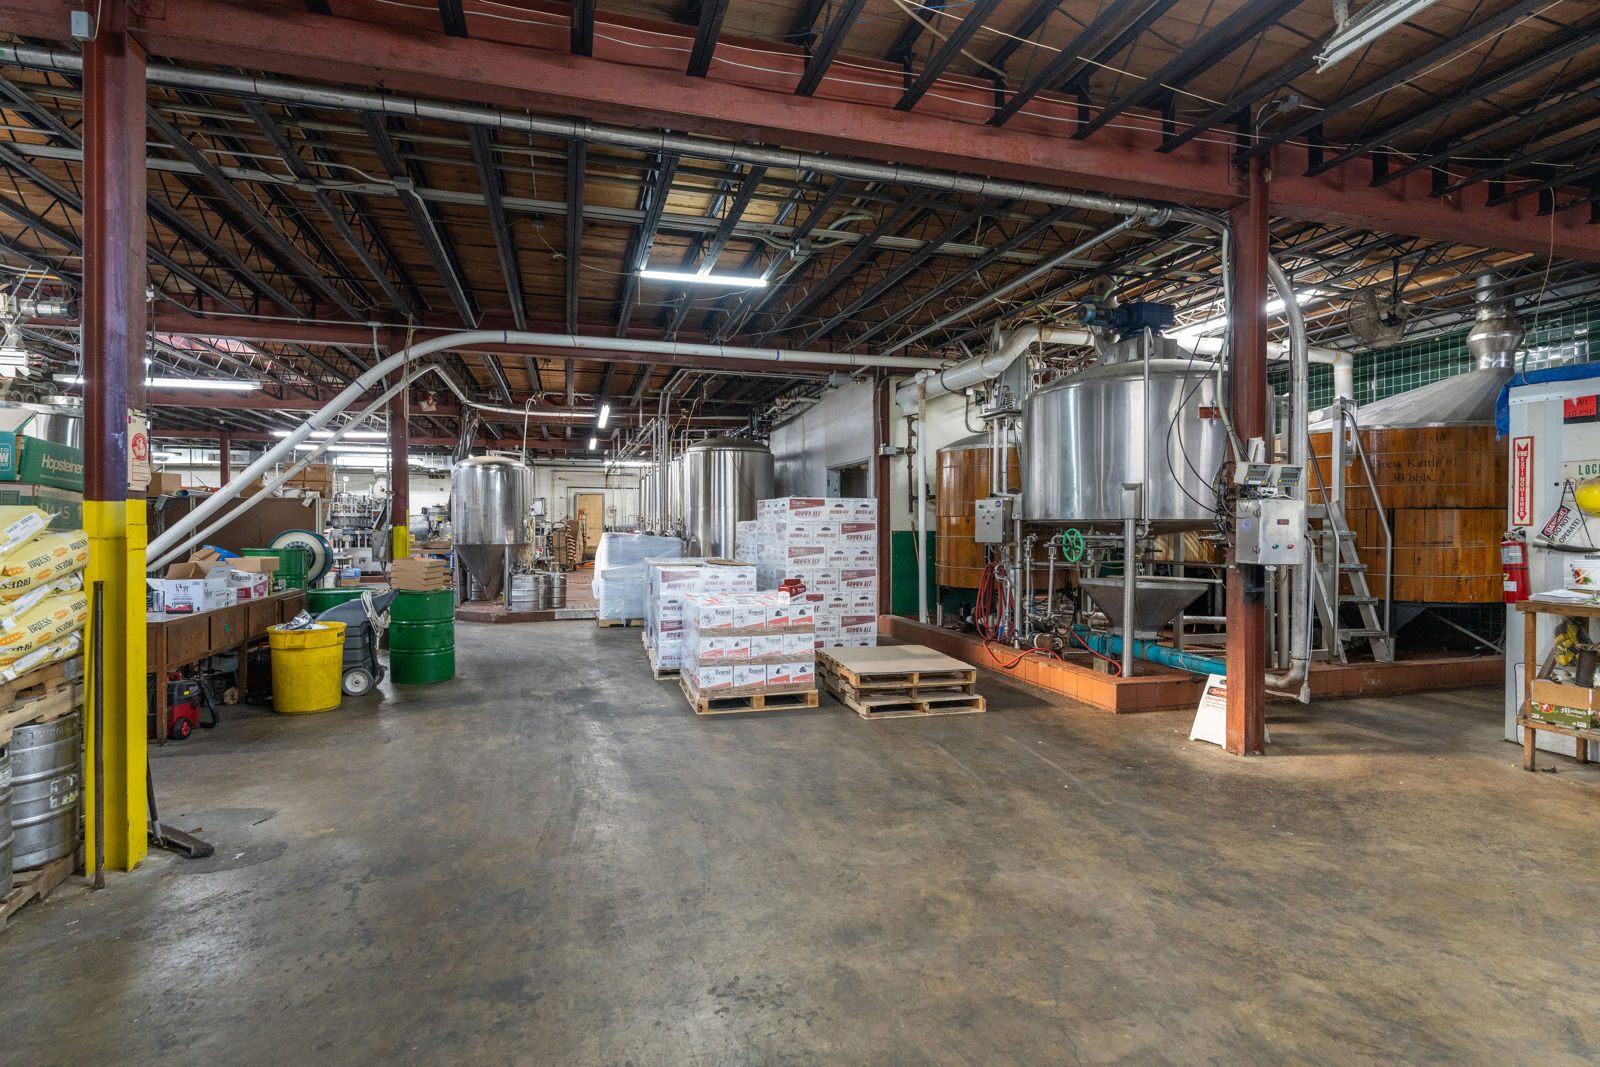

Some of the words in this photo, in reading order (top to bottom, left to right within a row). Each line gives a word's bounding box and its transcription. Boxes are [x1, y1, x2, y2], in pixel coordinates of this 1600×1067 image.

[41, 454, 83, 474] Hopsteiner
[1546, 508, 1567, 533] DANGER
[1553, 526, 1562, 536] DO
[1560, 516, 1570, 530] NOT
[1559, 518, 1582, 543] OPERATE!
[69, 538, 88, 551] BRIESS
[28, 554, 52, 569] BRIESS
[55, 558, 74, 572] BRIESS
[27, 617, 52, 634] BRIESS
[56, 619, 74, 633] BRIESS
